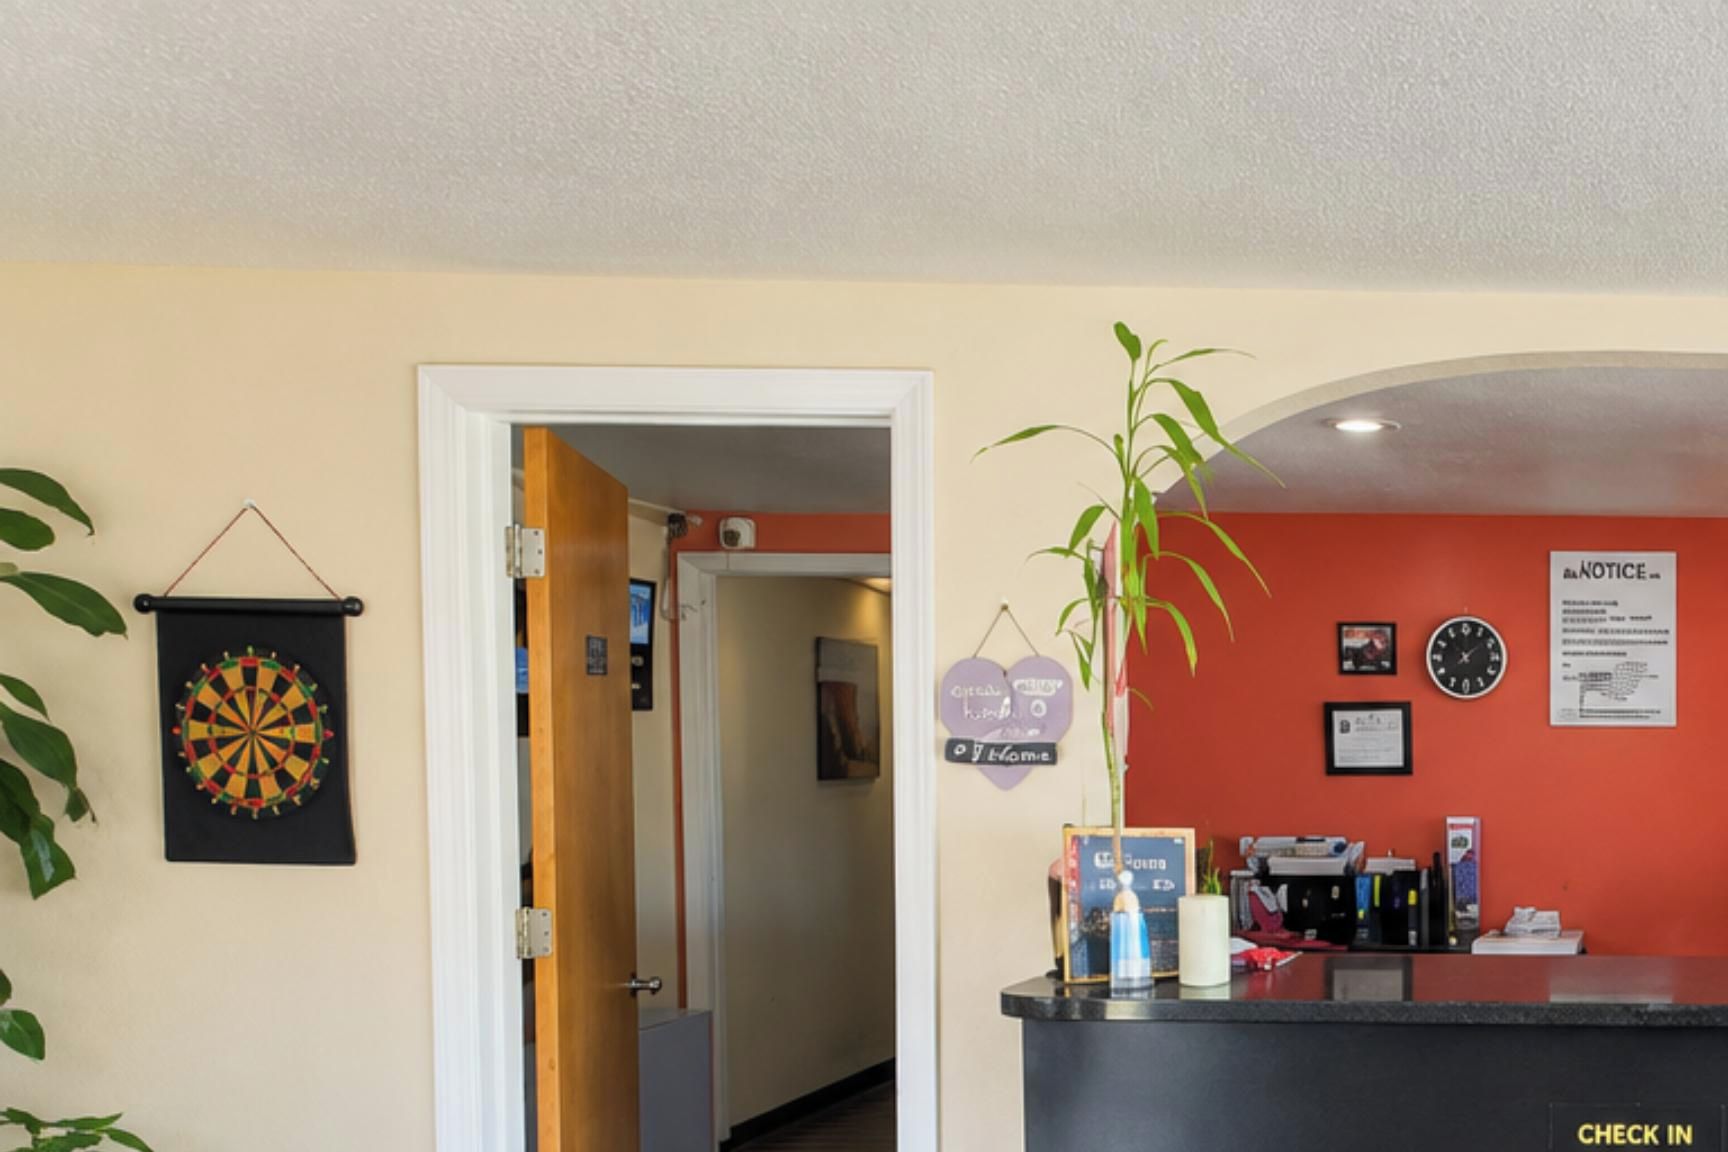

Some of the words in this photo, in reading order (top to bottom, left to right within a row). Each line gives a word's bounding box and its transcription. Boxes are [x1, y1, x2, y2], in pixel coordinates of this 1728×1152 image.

[1579, 560, 1647, 580] NOTICE
[1577, 1123, 1660, 1146] CHECK
[1666, 1123, 1694, 1146] IN
